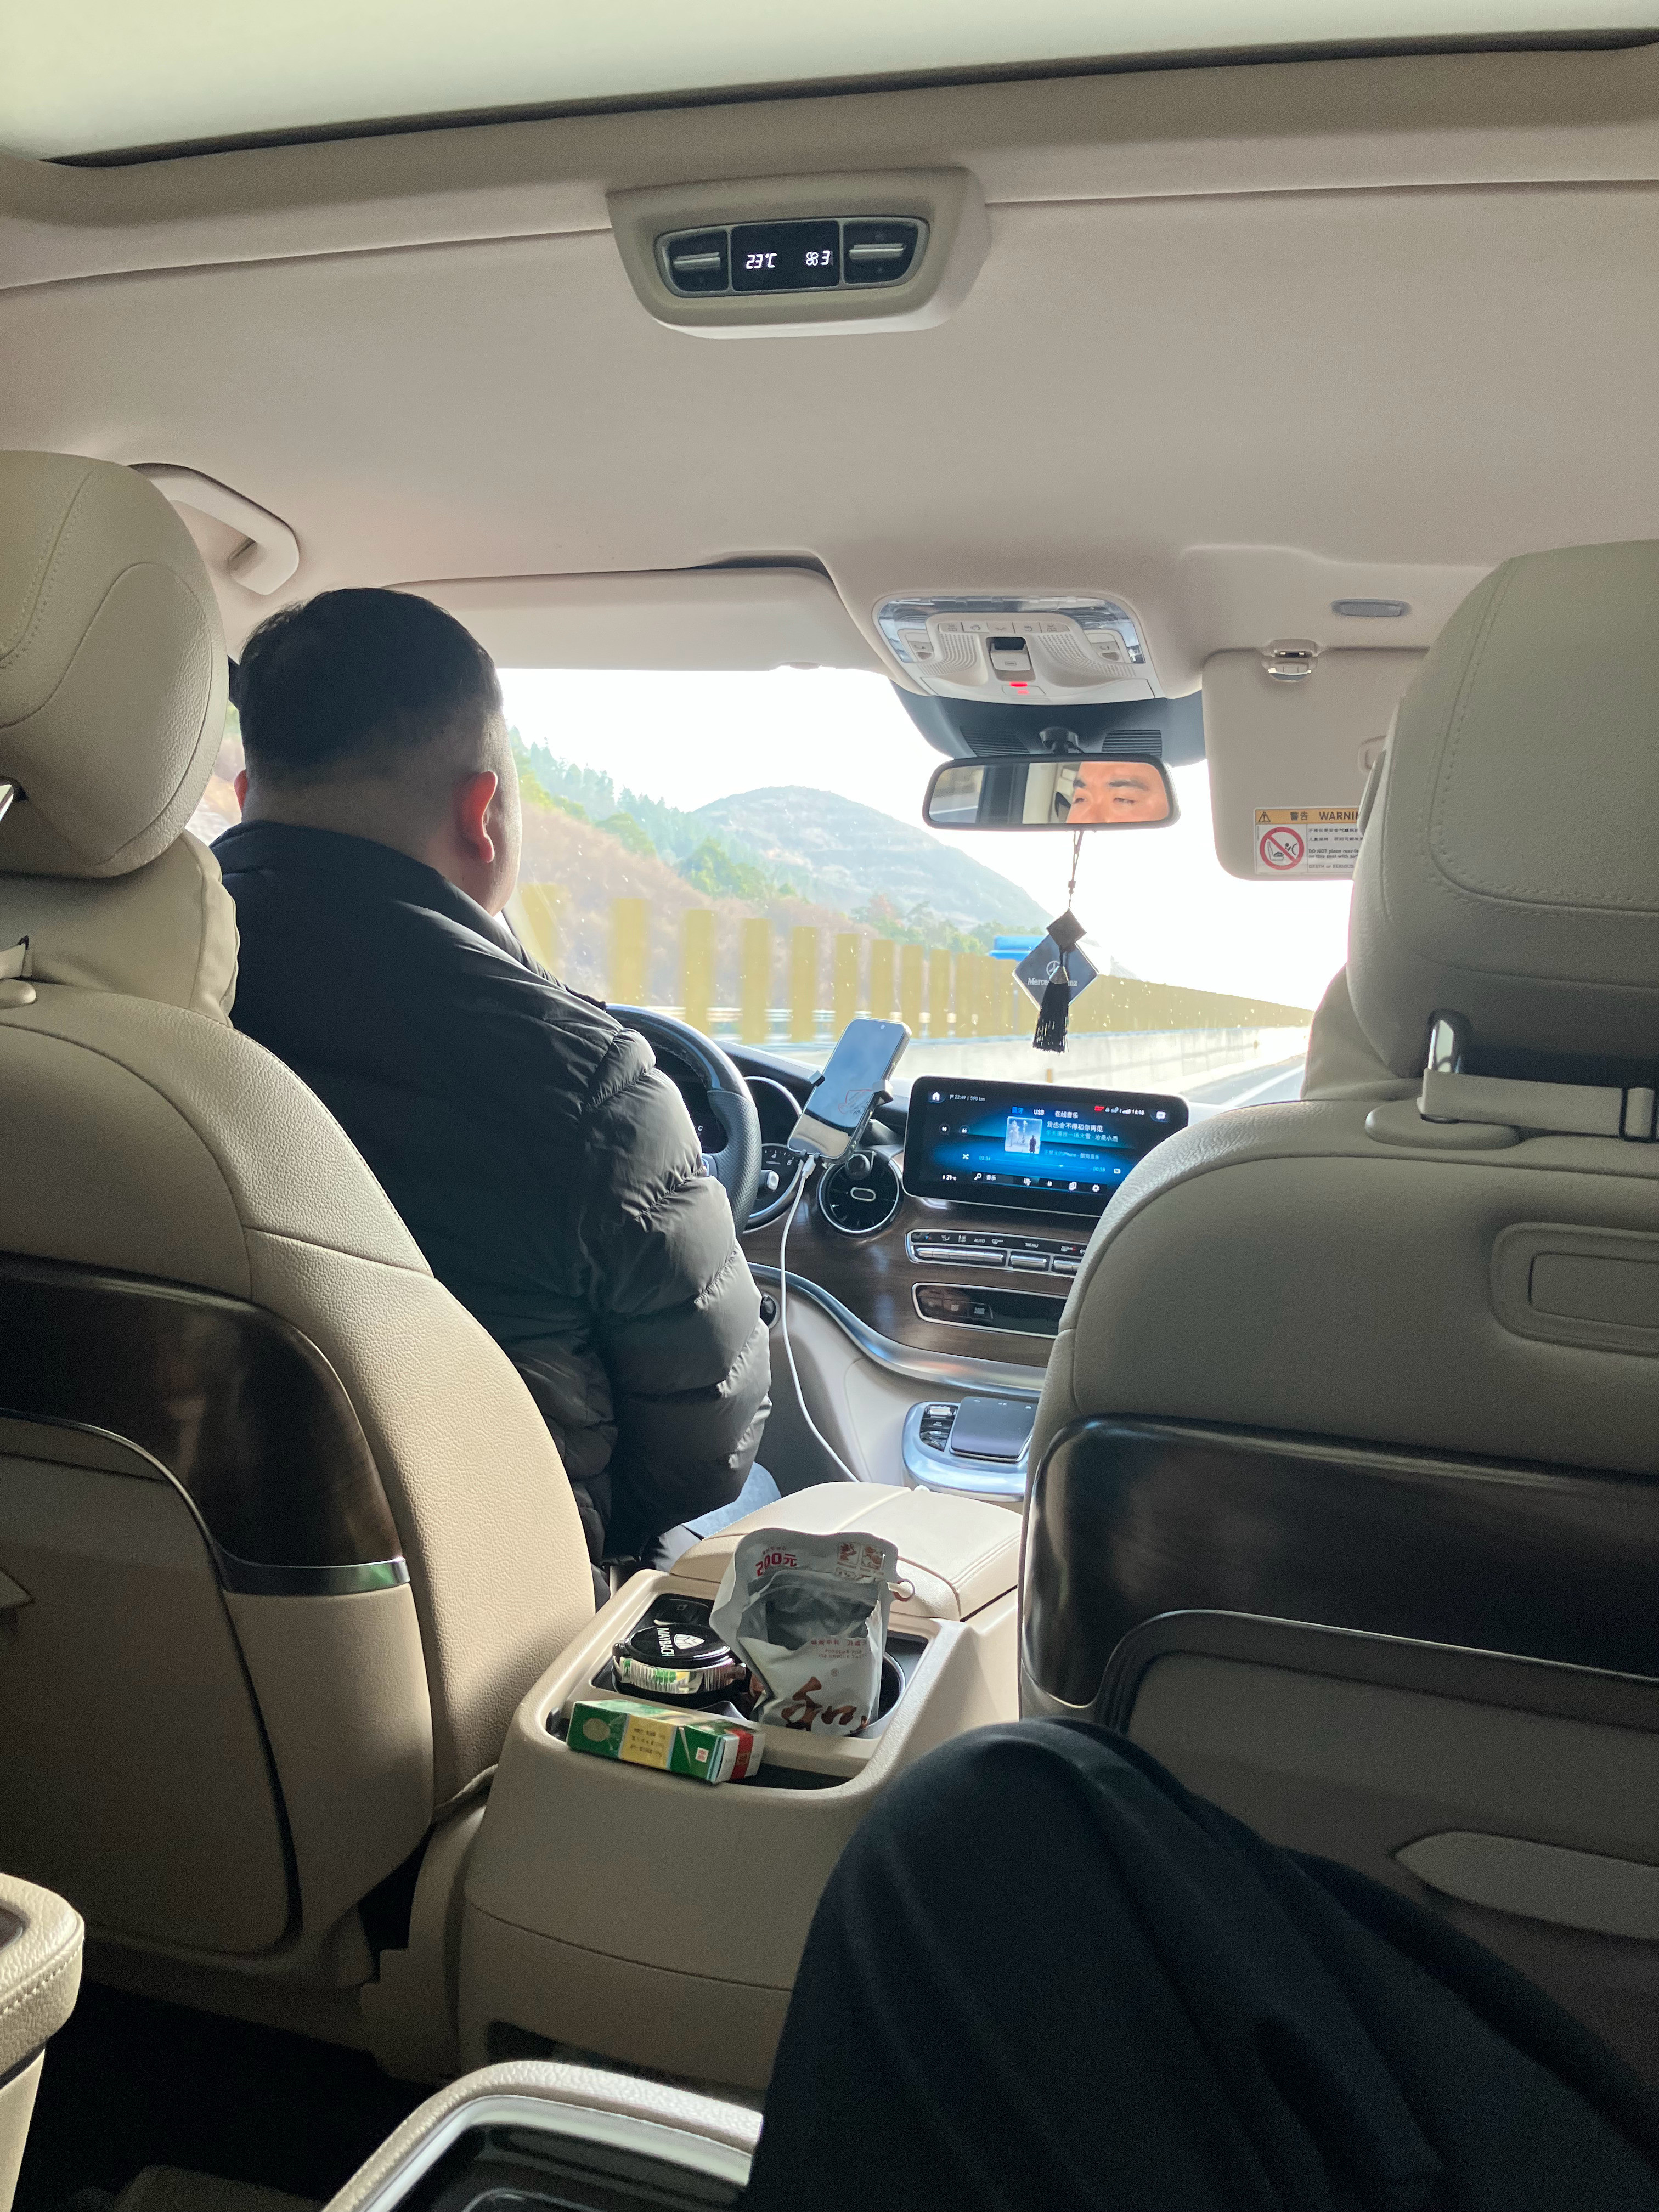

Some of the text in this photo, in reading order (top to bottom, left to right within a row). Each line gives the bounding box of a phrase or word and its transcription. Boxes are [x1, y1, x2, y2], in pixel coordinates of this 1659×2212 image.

[1290, 811, 1308, 821] 警告
[1055, 1111, 1079, 1119] 在线音乐
[657, 1627, 675, 1657] MAYBACH
